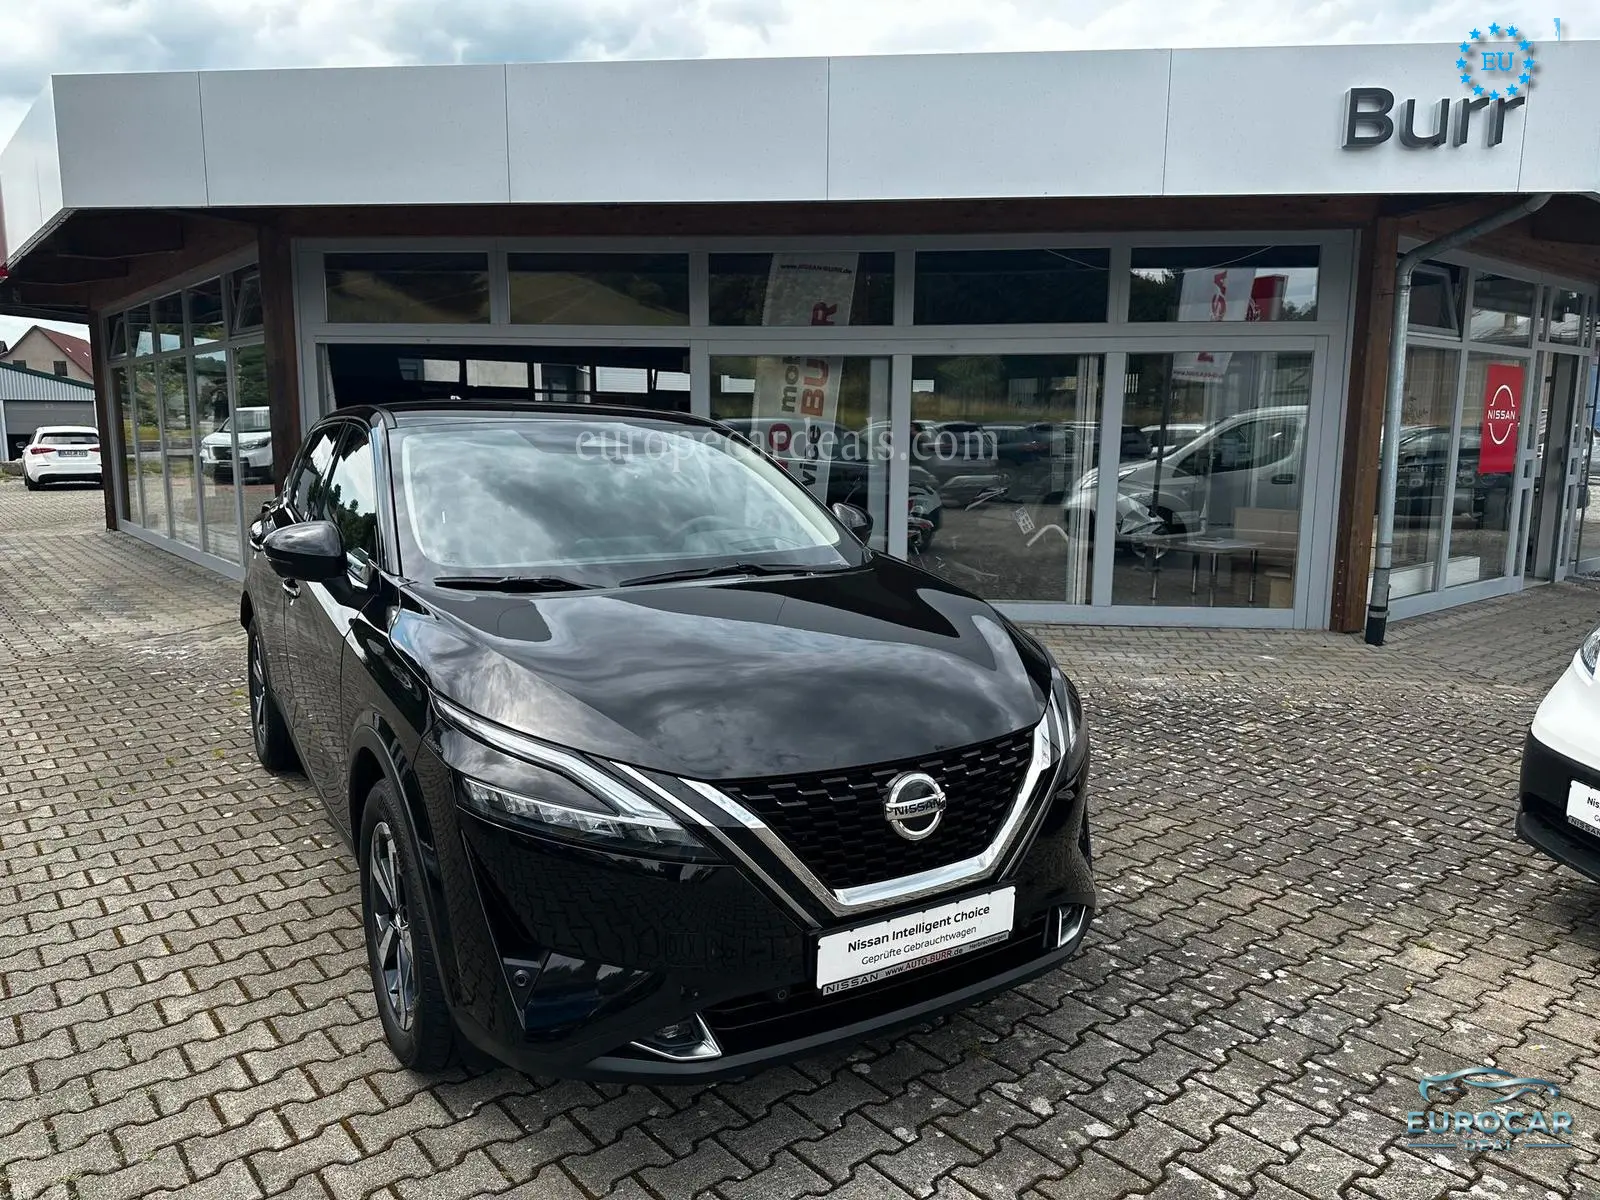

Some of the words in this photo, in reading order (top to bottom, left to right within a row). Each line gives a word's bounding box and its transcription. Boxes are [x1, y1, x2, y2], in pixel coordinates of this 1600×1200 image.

[1342, 87, 1526, 149] Burr
[800, 302, 837, 417] BUR
[1487, 409, 1516, 420] NISSAN
[894, 798, 941, 816] NISSAN
[848, 934, 889, 952] Nissan
[892, 916, 951, 941] Intelligent
[953, 905, 990, 923] Choice
[861, 944, 902, 965] Geprüfte
[903, 925, 977, 953] Gebrauchtwagen
[825, 973, 879, 994] NISSAN
[885, 947, 963, 977] www.AUTO-BURR.de
